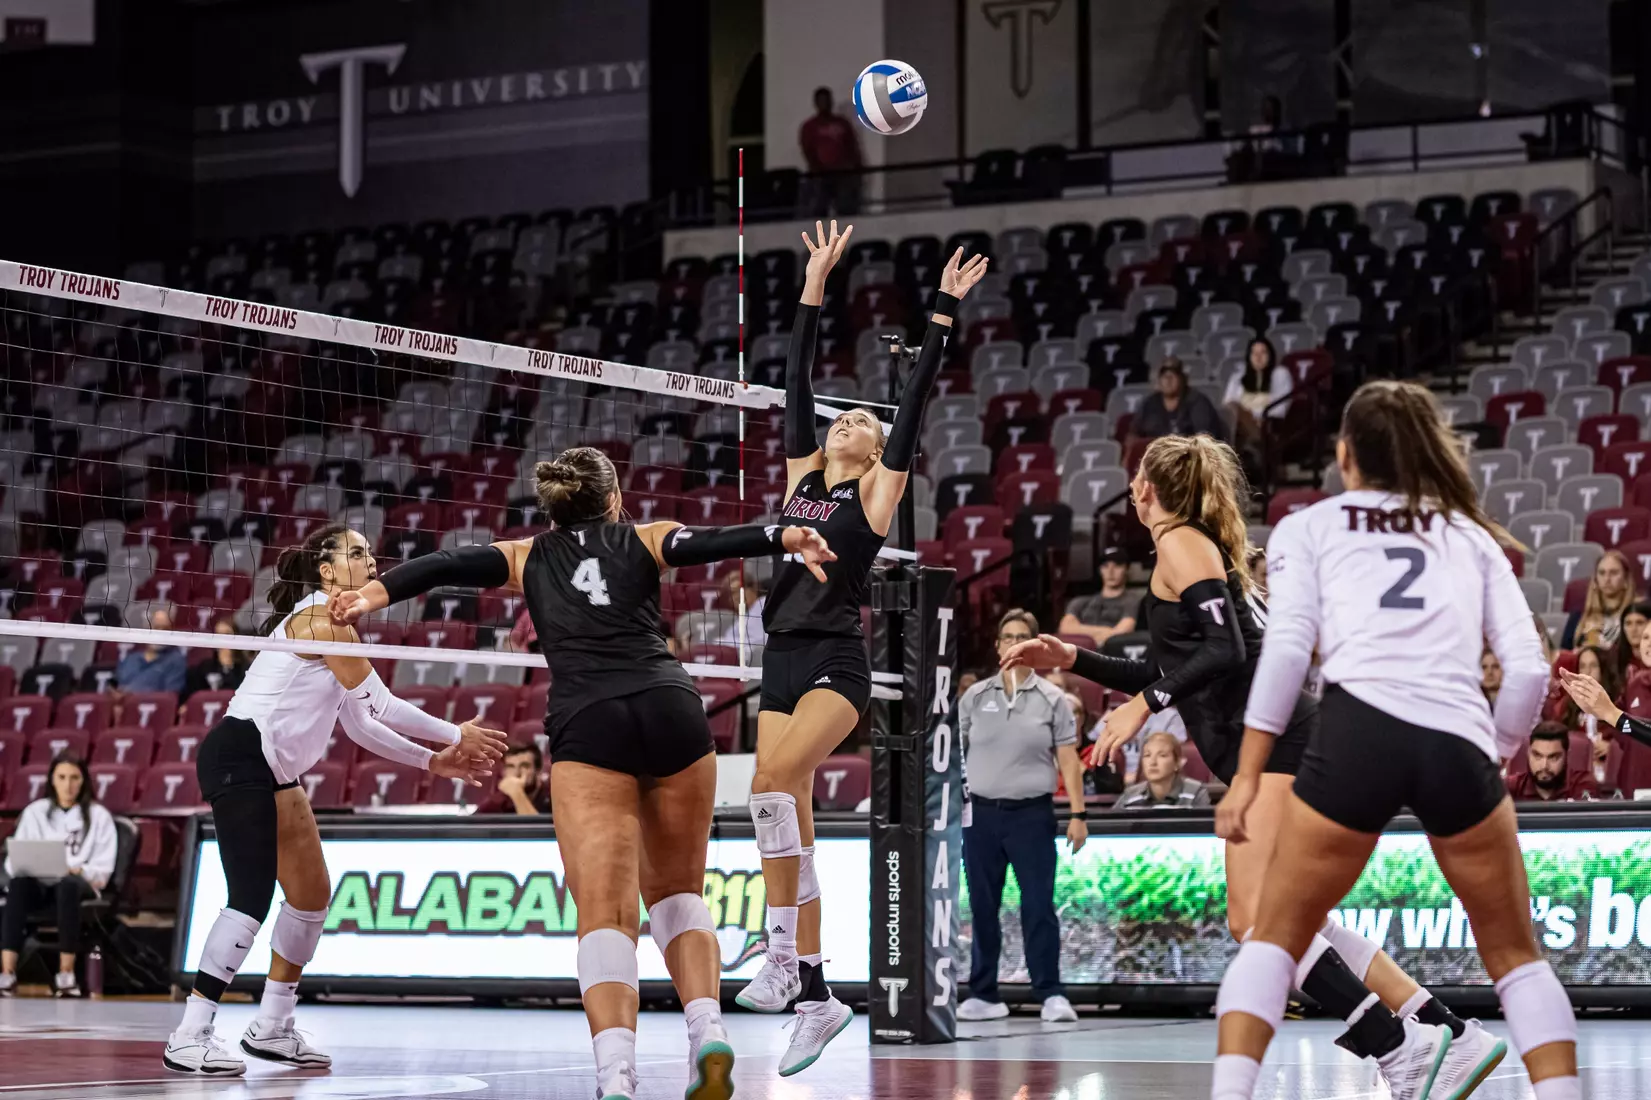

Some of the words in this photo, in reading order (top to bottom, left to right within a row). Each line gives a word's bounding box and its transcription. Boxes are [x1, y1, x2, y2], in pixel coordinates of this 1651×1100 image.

[216, 97, 317, 132] TROY
[388, 61, 646, 114] UNIVERSITY
[299, 43, 408, 198] T
[19, 265, 55, 289] TROY
[60, 272, 121, 300] TROJANS
[205, 296, 238, 320] TROY
[241, 303, 297, 330] TROJANS
[374, 325, 405, 346] TROY
[408, 331, 458, 355] TROJANS
[527, 350, 555, 369] TROY
[558, 356, 603, 378] TROJANS
[666, 373, 691, 391] TROY
[694, 377, 735, 399] TROJANS
[784, 496, 840, 521] TROY
[1341, 505, 1436, 534] TROY
[570, 557, 611, 606] 4
[1380, 547, 1425, 609] 2
[1198, 597, 1225, 626] T
[931, 607, 954, 1006] TROJANS
[886, 851, 902, 902] sports
[886, 903, 902, 965] imports
[878, 978, 909, 1018] T
